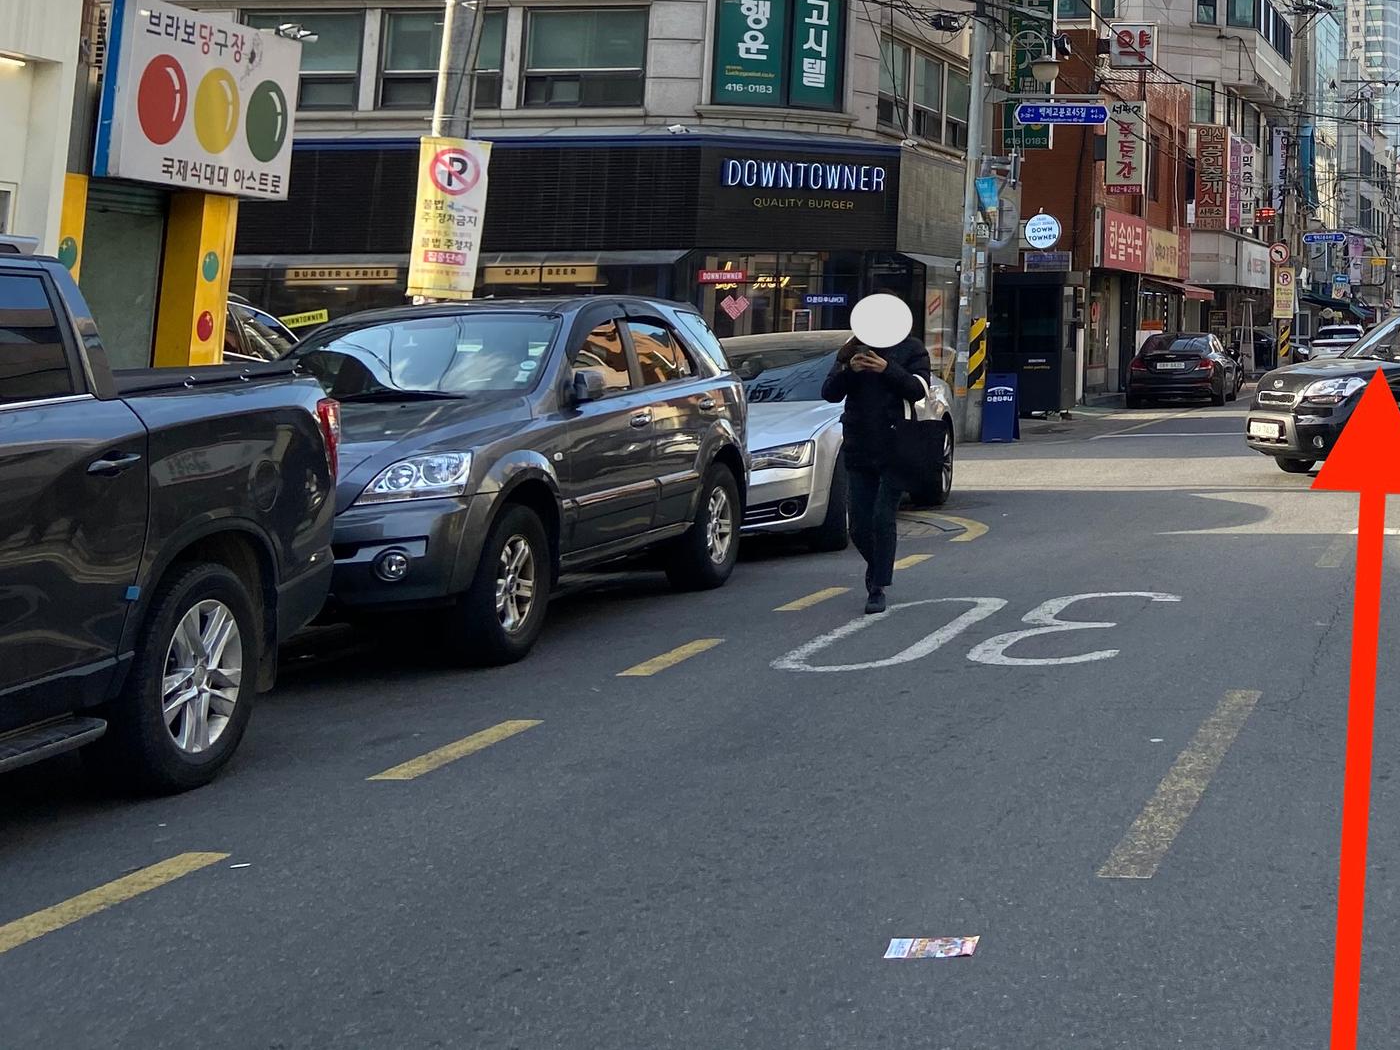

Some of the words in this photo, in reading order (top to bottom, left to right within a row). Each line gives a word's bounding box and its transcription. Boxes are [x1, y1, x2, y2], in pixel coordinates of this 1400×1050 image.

[725, 82, 773, 94] 416-0183
[162, 157, 229, 188] 국제식대대
[233, 167, 282, 195] 아스트로
[727, 159, 886, 192] DOWNTOWNER
[753, 197, 803, 208] QUALITY
[808, 199, 854, 210] BURGER
[1109, 220, 1143, 263] 한솔약국
[294, 270, 342, 279] BURGER
[354, 269, 390, 278] FRIES
[547, 267, 578, 276] BEER
[703, 271, 743, 281] DOWNTOWNER
